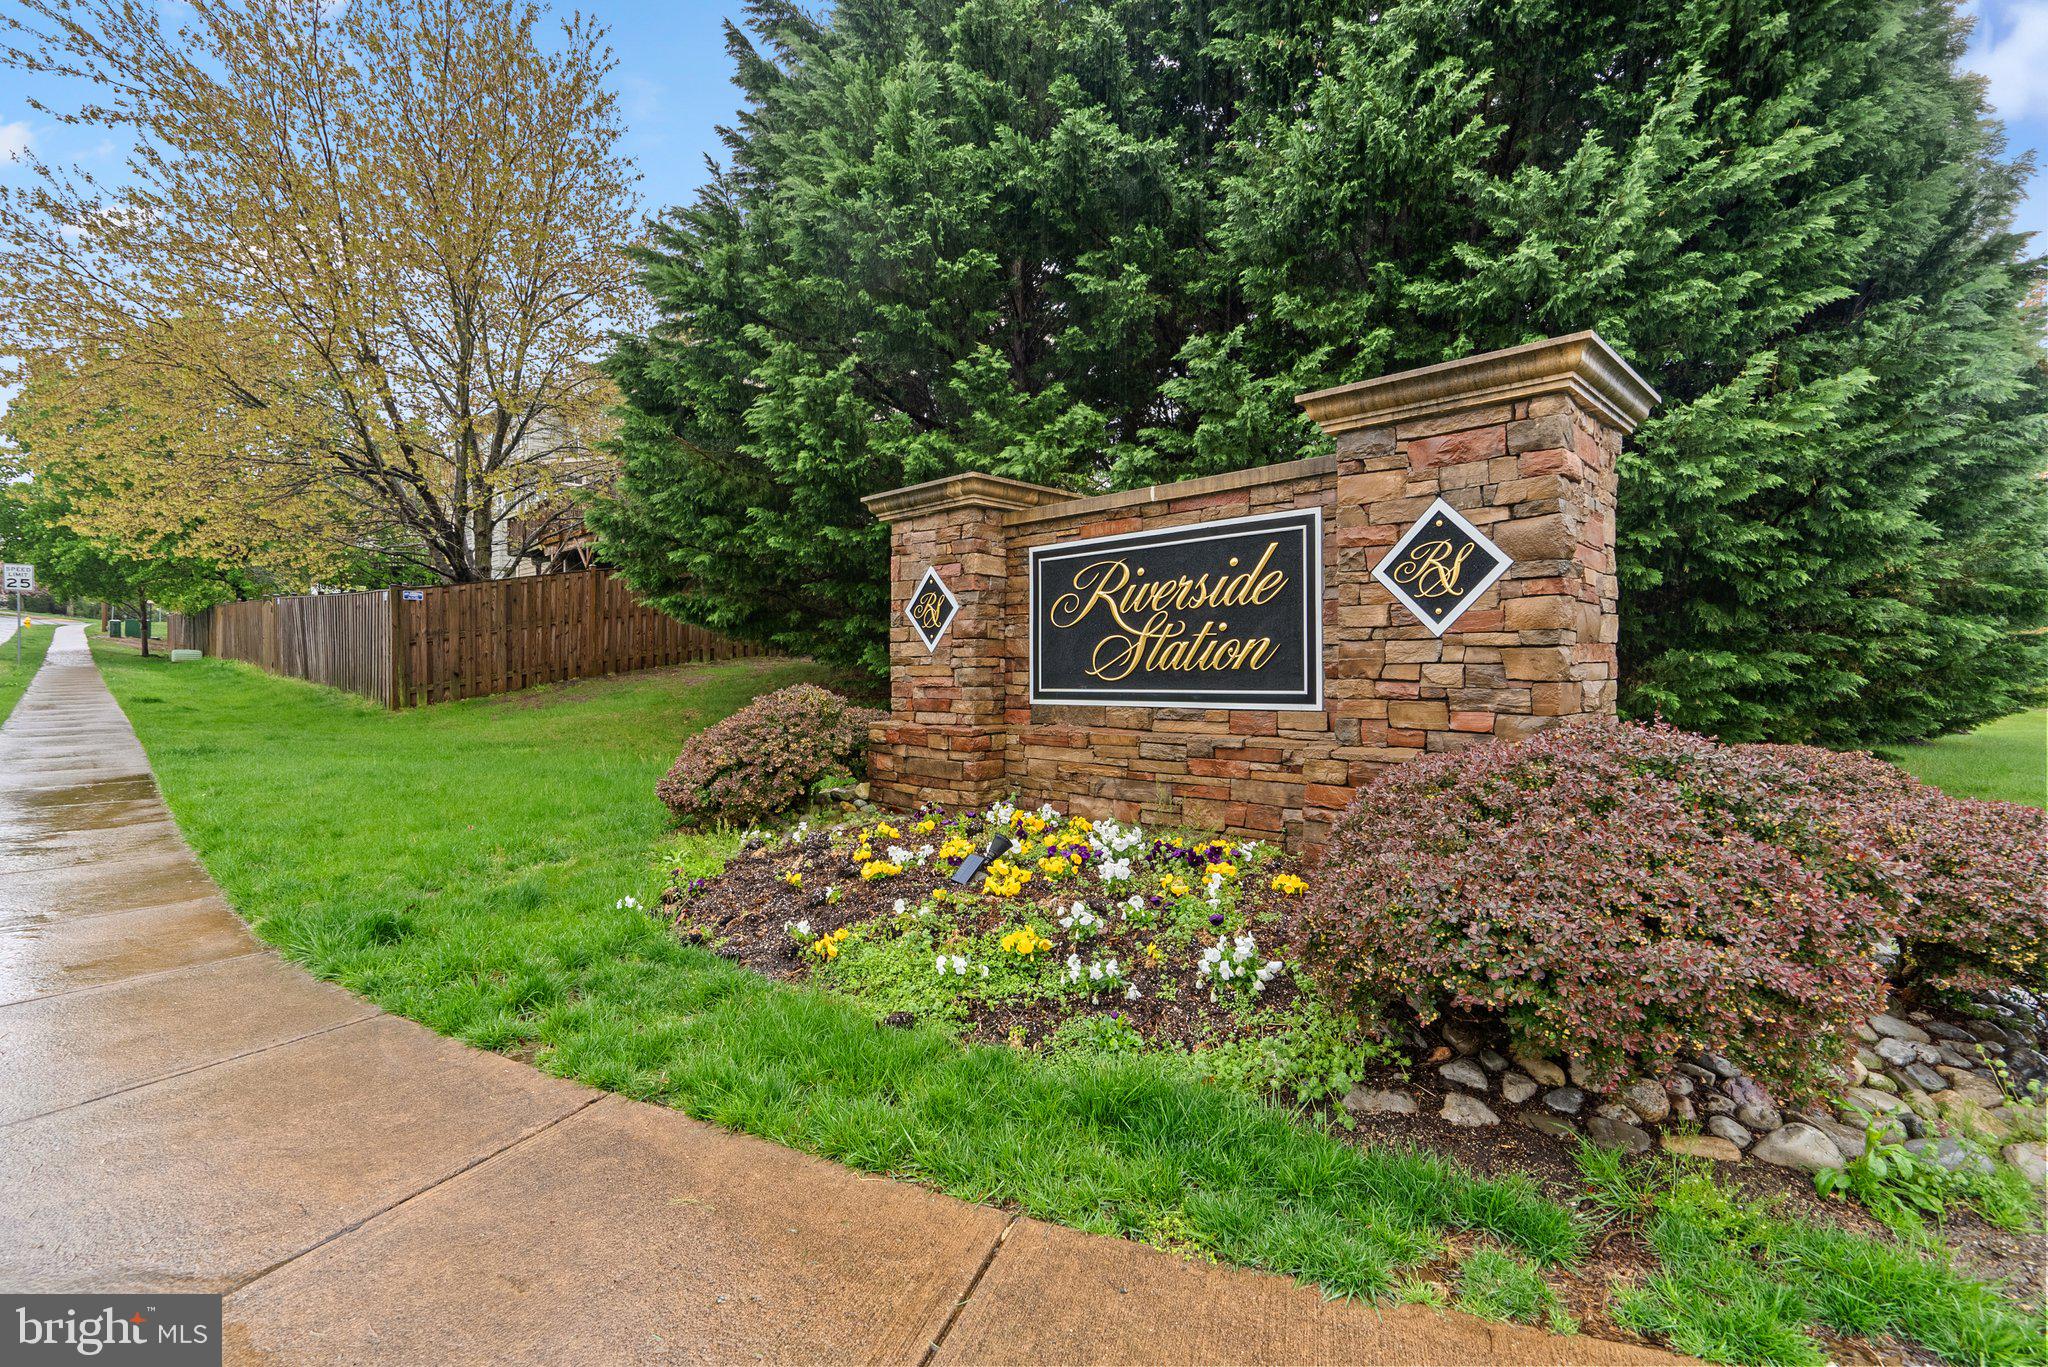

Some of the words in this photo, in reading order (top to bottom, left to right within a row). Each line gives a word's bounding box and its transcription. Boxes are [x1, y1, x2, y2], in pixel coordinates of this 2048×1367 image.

[6, 577, 31, 588] 25
[1050, 541, 1289, 628] Riverside
[1084, 610, 1281, 681] Station
